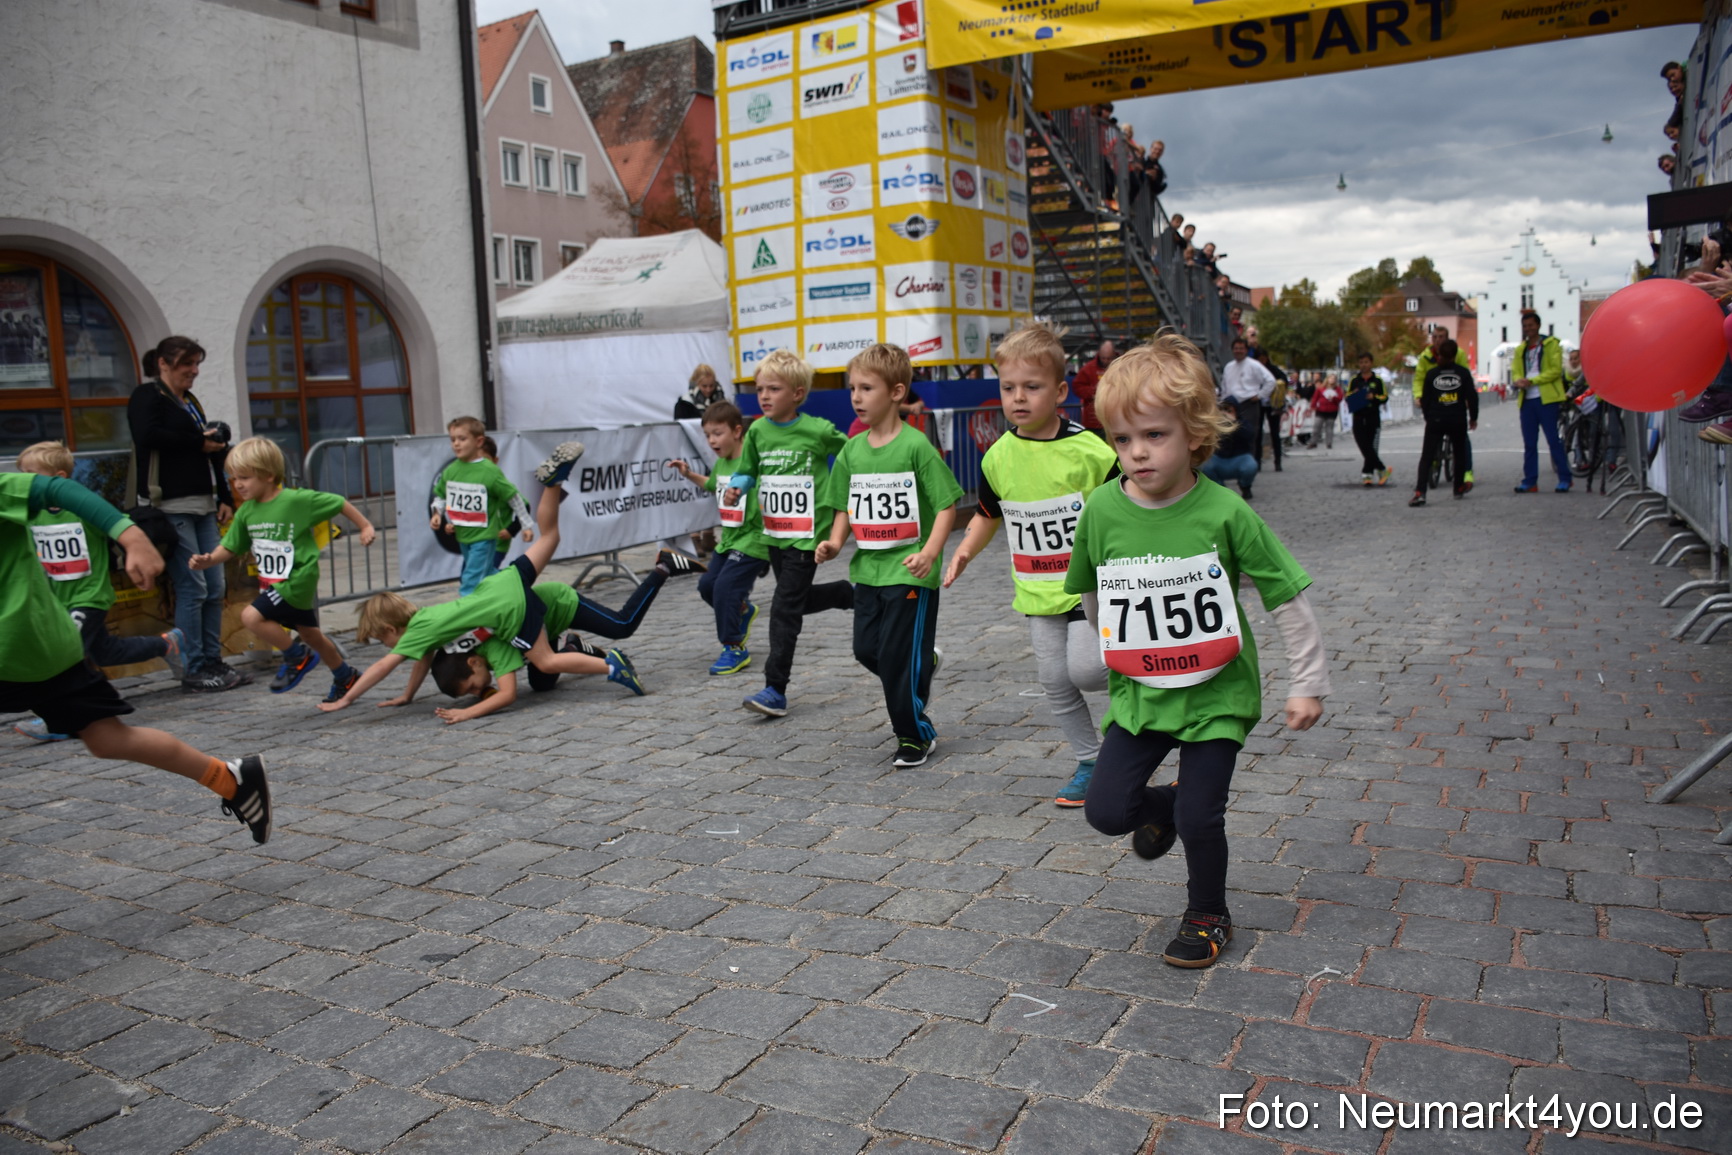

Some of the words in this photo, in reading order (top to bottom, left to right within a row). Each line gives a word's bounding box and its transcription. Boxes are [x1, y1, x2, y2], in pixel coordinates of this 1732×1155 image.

[958, 11, 1037, 32] Neumarkter
[1040, 0, 1100, 21] Stadtlauf
[1501, 0, 1588, 21] Neumarkter
[1228, 0, 1452, 68] START
[730, 48, 790, 72] RÖDL
[1063, 65, 1132, 83] Neumarkter
[1134, 56, 1191, 75] Stadtlauf
[803, 82, 844, 103] swn
[750, 198, 791, 214] VARIOTEC
[806, 232, 872, 252] RÖDL
[580, 463, 628, 493] BMW
[866, 481, 901, 489] Neumarkt
[450, 492, 482, 511] 7423
[583, 496, 636, 518] WENIGER
[761, 491, 808, 514] 7009
[851, 492, 910, 520] 7135
[1003, 508, 1024, 518] PARTL
[1024, 506, 1068, 518] Neumarkt
[862, 527, 898, 539] Vincent
[1011, 516, 1078, 551] 7155
[38, 537, 81, 559] 7190
[1030, 558, 1070, 571] Marian
[1100, 579, 1135, 591] PARTL
[1138, 570, 1204, 589] Neumarkt
[1110, 587, 1223, 643] 7156
[1142, 653, 1200, 672] Simon
